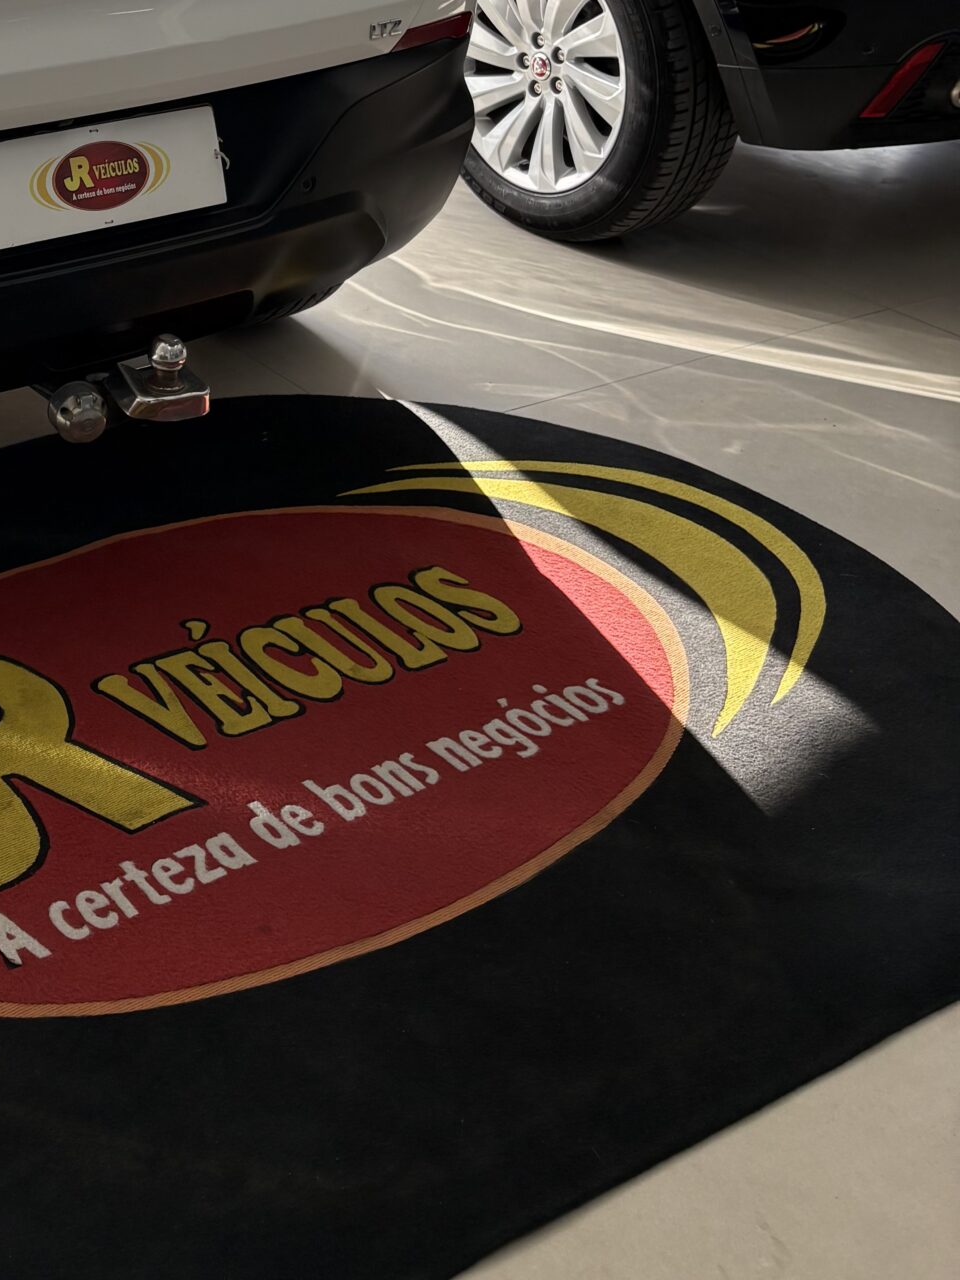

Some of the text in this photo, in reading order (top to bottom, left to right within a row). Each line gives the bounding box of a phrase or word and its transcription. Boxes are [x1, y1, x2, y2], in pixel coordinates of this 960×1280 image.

[369, 18, 402, 40] LTZ
[63, 155, 140, 192] JR VEÍCULOS
[90, 564, 523, 751] VEÍCULOS
[48, 830, 259, 942] certeza
[248, 798, 326, 851] de
[302, 749, 441, 824] bons
[427, 673, 628, 773] negócios
